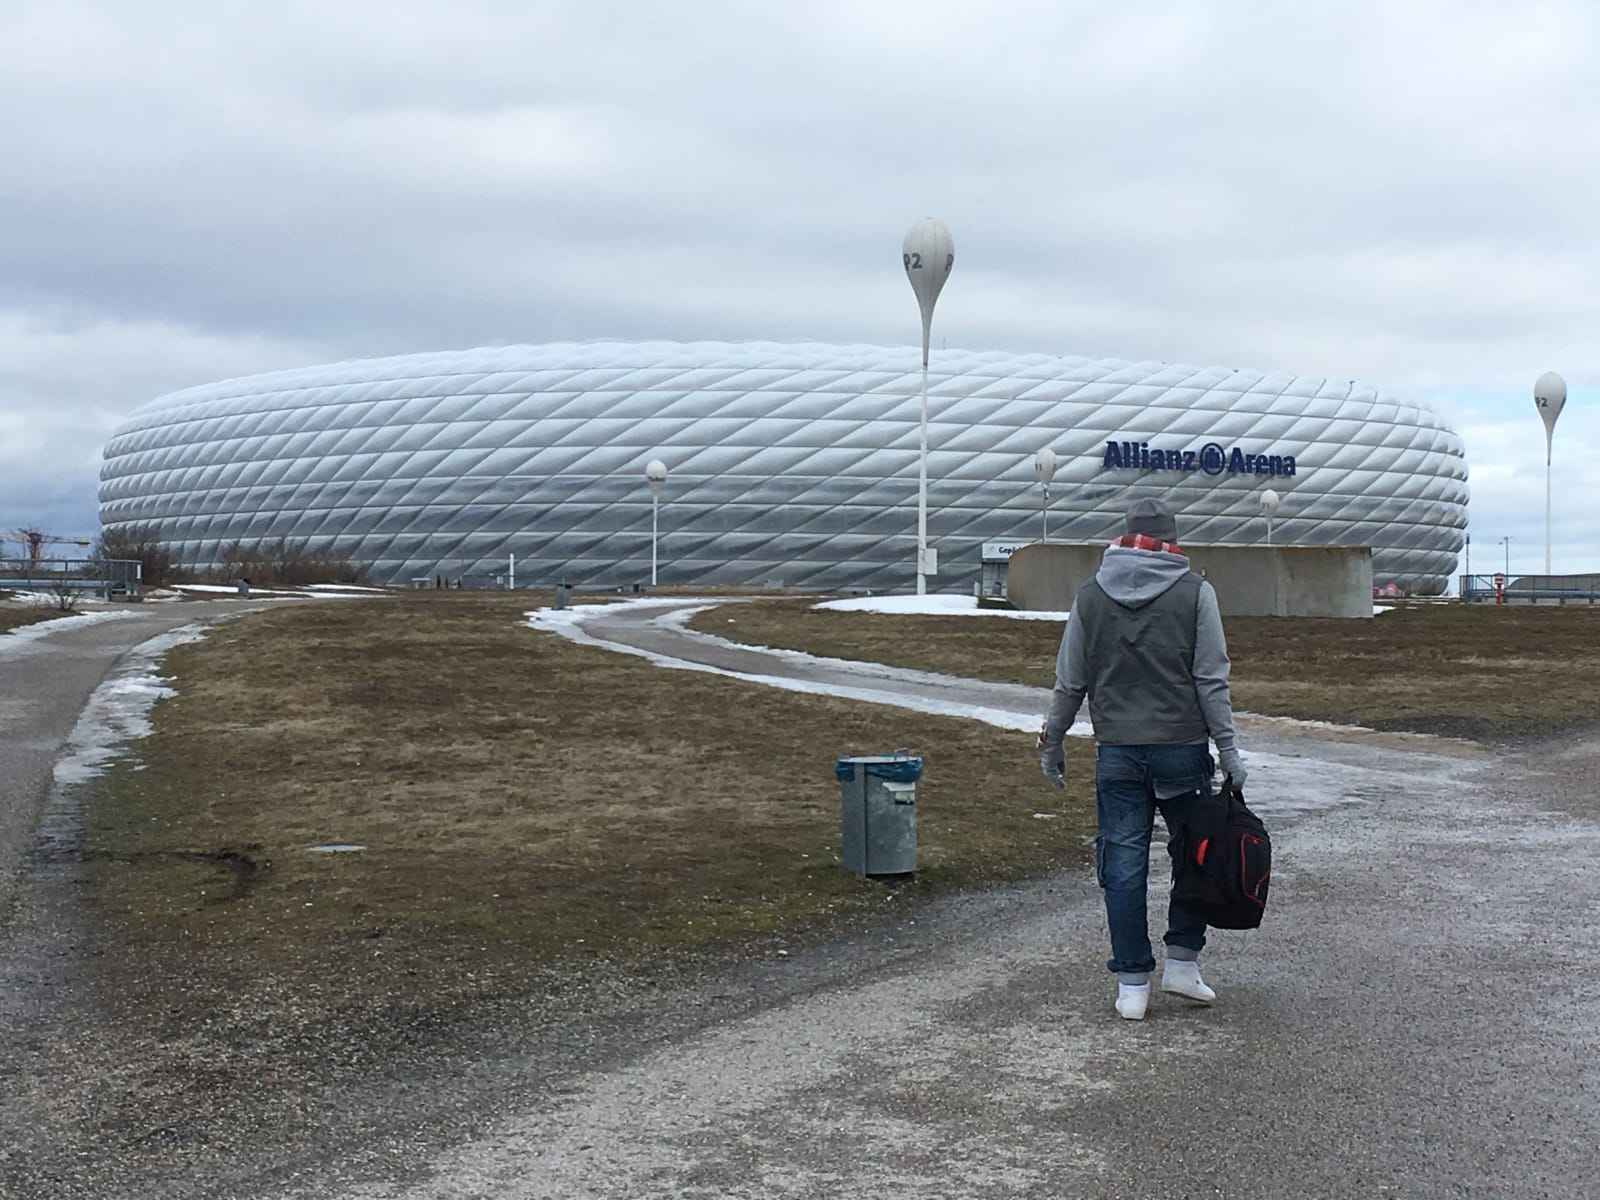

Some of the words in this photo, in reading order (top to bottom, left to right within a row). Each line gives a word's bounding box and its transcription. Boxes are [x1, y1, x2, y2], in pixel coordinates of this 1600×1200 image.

[903, 252, 922, 271] P2
[1103, 440, 1197, 471] Allianz
[1228, 446, 1297, 476] Arena
